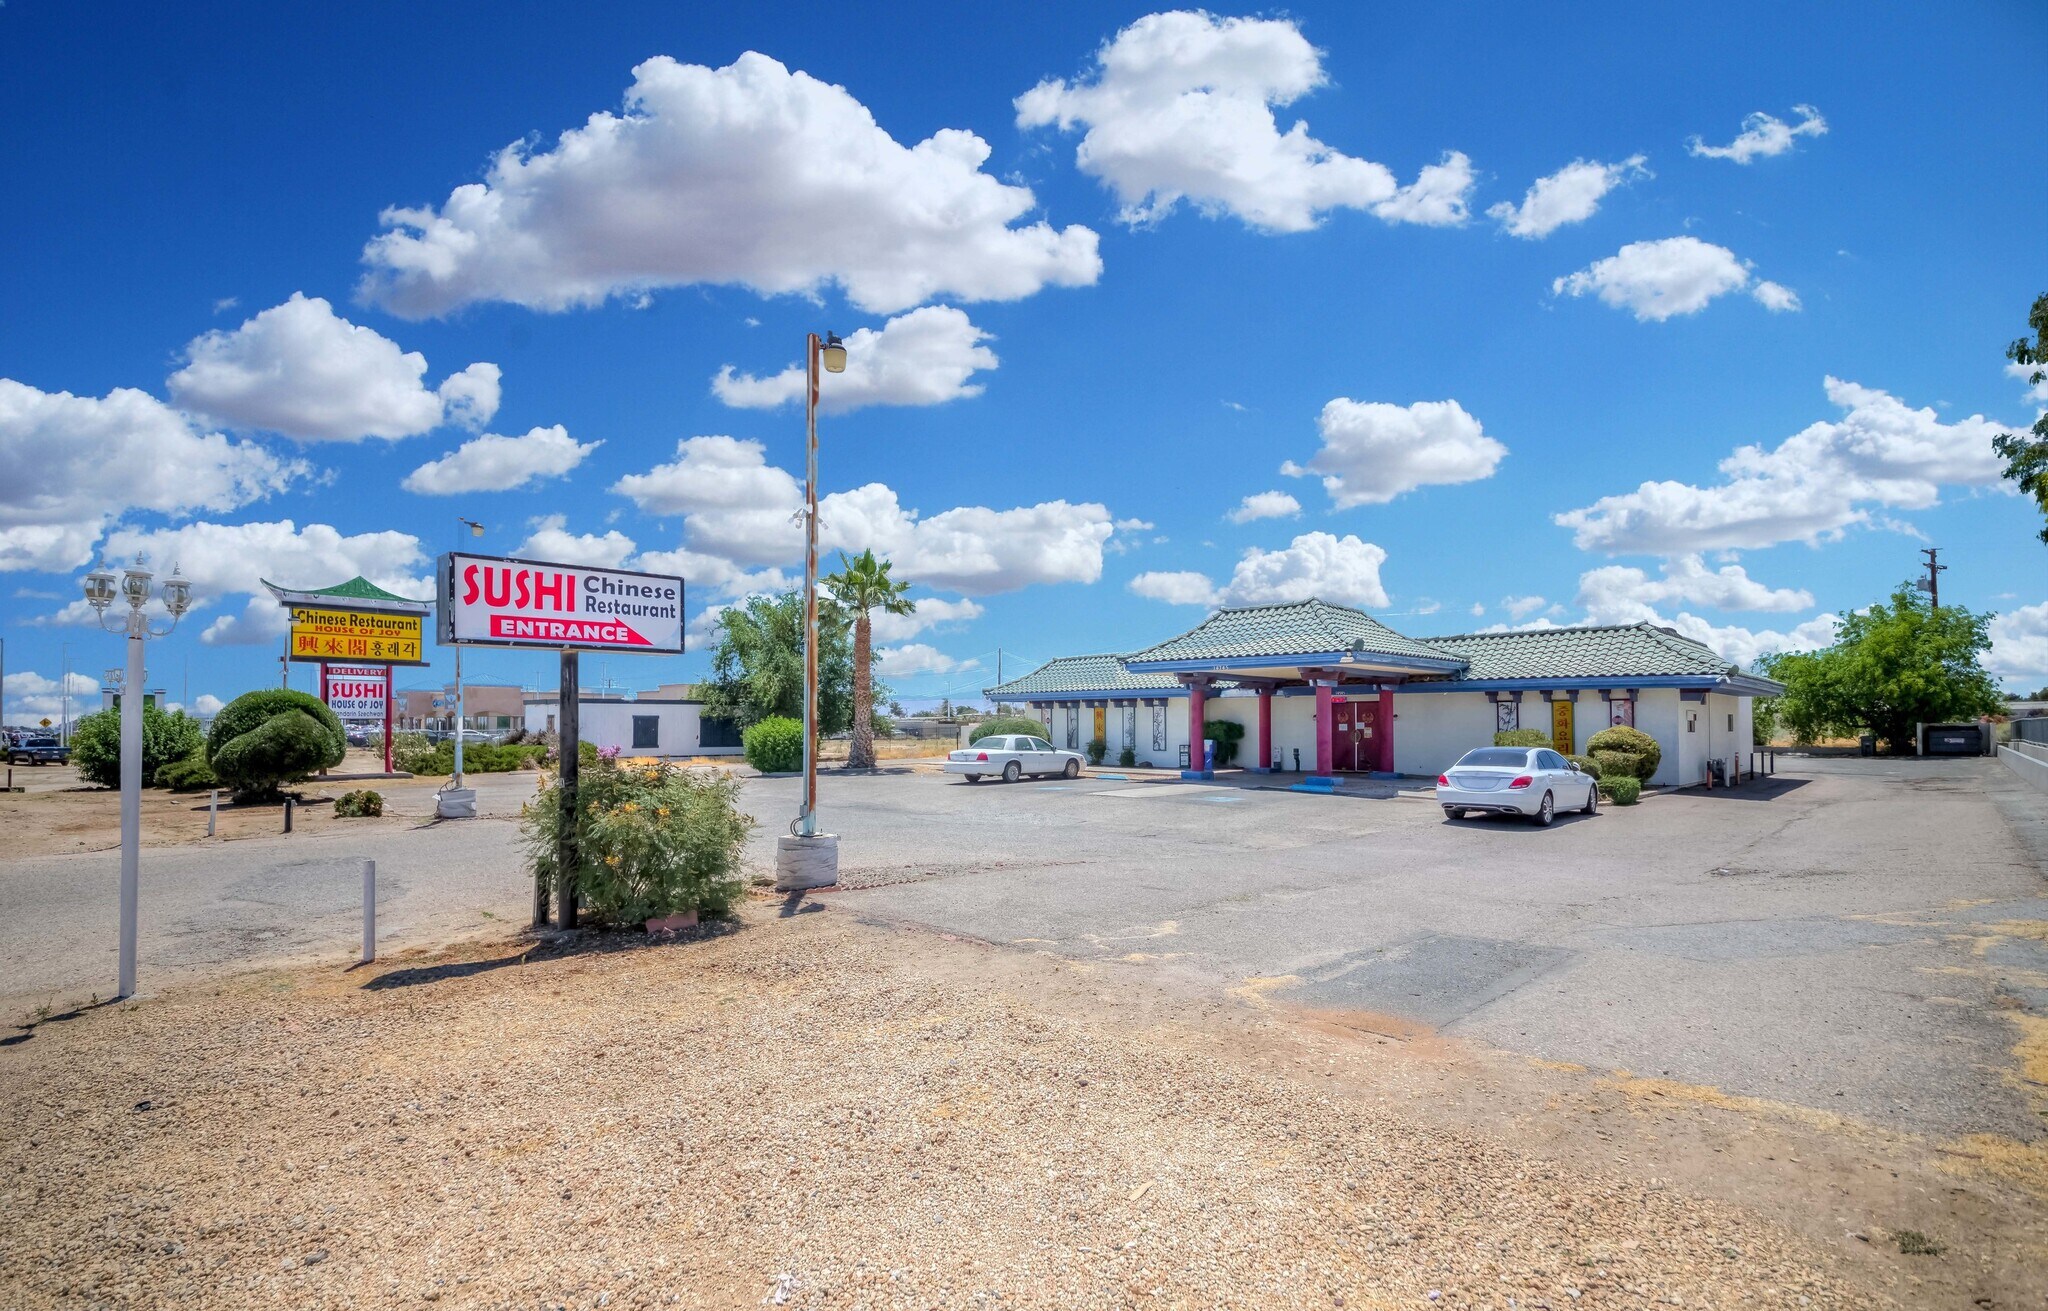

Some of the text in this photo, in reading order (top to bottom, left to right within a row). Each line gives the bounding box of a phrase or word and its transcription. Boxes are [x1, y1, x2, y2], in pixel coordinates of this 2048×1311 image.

[463, 564, 576, 613] SUSHI
[583, 575, 676, 600] Chinese
[585, 595, 677, 619] Restaurant
[297, 610, 418, 631] Chinese Restaurant
[315, 625, 355, 634] HOUSE
[379, 629, 401, 637] JOY
[500, 619, 629, 641] ENTRANCE
[332, 668, 384, 676] DELIVERY
[332, 682, 384, 698] SUSHI
[331, 700, 384, 709] HOUSE OF JOY
